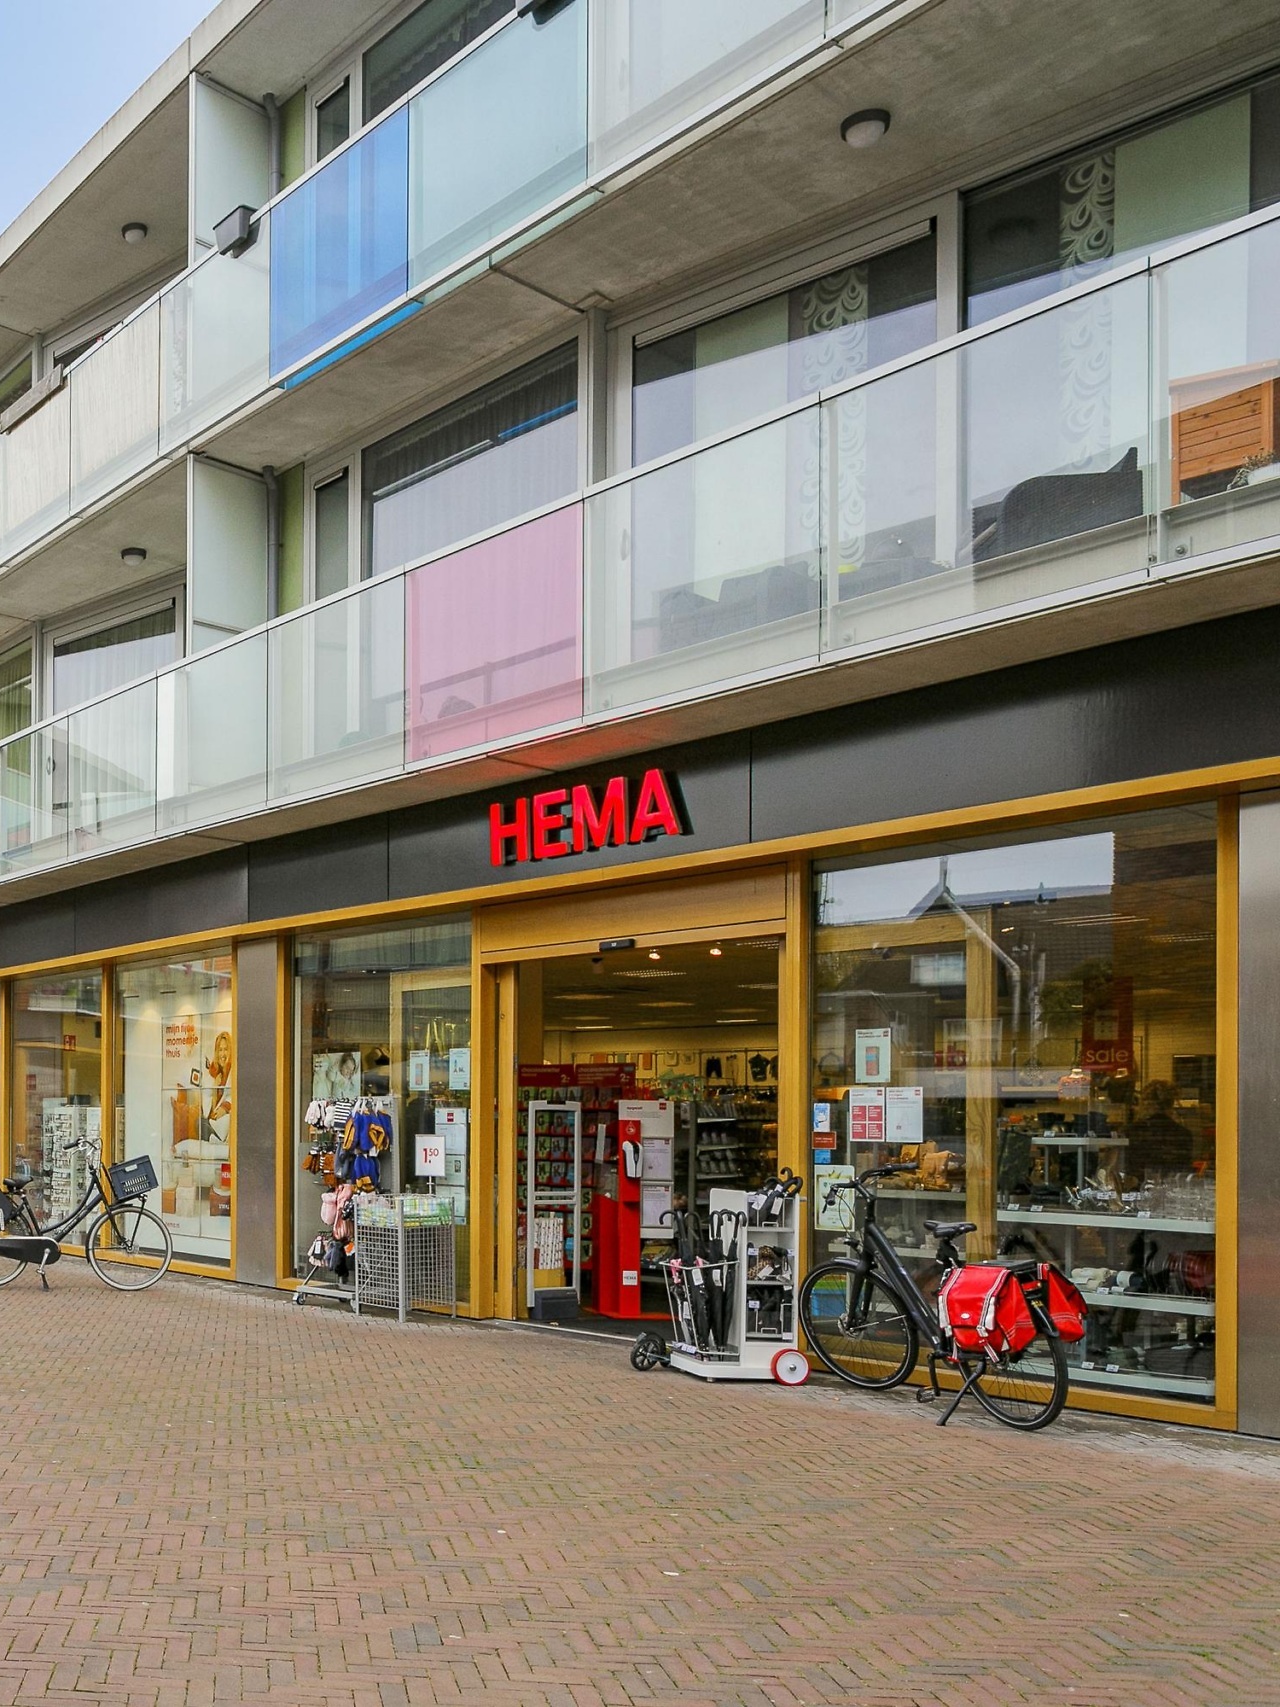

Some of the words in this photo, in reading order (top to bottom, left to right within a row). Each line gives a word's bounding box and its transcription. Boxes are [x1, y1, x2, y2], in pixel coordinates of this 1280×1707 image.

[489, 768, 680, 868] HEMA
[166, 1047, 180, 1058] thuis
[1085, 1047, 1129, 1064] sale
